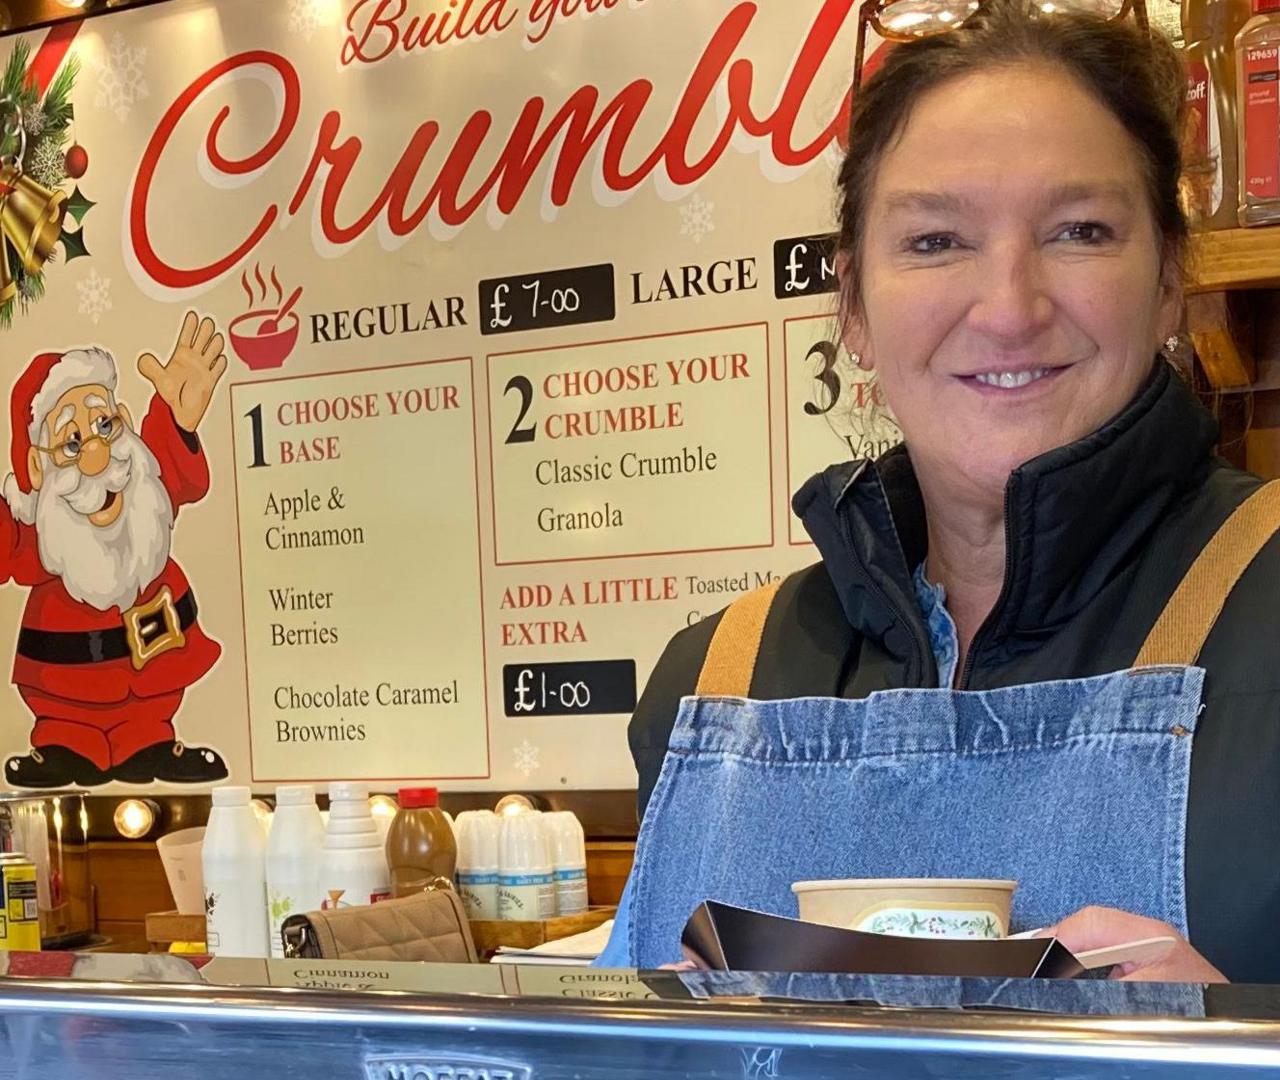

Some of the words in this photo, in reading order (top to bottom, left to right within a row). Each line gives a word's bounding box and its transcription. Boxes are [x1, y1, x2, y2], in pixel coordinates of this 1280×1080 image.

[340, 0, 518, 66] Build
[310, 296, 468, 344] REGULAR
[630, 257, 758, 305] LARGE
[804, 340, 841, 415] 3
[503, 375, 538, 444] 2
[543, 363, 659, 400] CHOOSE
[666, 353, 751, 384] YOUR
[244, 404, 272, 469] 1
[277, 393, 380, 427] CHOOSE
[386, 385, 460, 416] YOUR
[544, 402, 684, 440] CRUMBLE
[279, 435, 341, 466] BASE
[536, 455, 613, 486] Classic
[620, 447, 718, 478] Crumble
[264, 488, 322, 520] Apple
[327, 485, 345, 510] &
[537, 502, 624, 533] Granola
[265, 523, 365, 551] Cinnamon
[269, 587, 333, 614] Winter
[500, 584, 553, 611] ADD
[558, 582, 577, 607] A
[583, 575, 679, 605] LITTLE
[685, 571, 749, 595] Toasted
[271, 621, 338, 648] Berries
[501, 619, 587, 647] EXTRA
[274, 683, 370, 711] Chocolate
[375, 680, 459, 706] Caramel
[276, 716, 366, 743] Brownies
